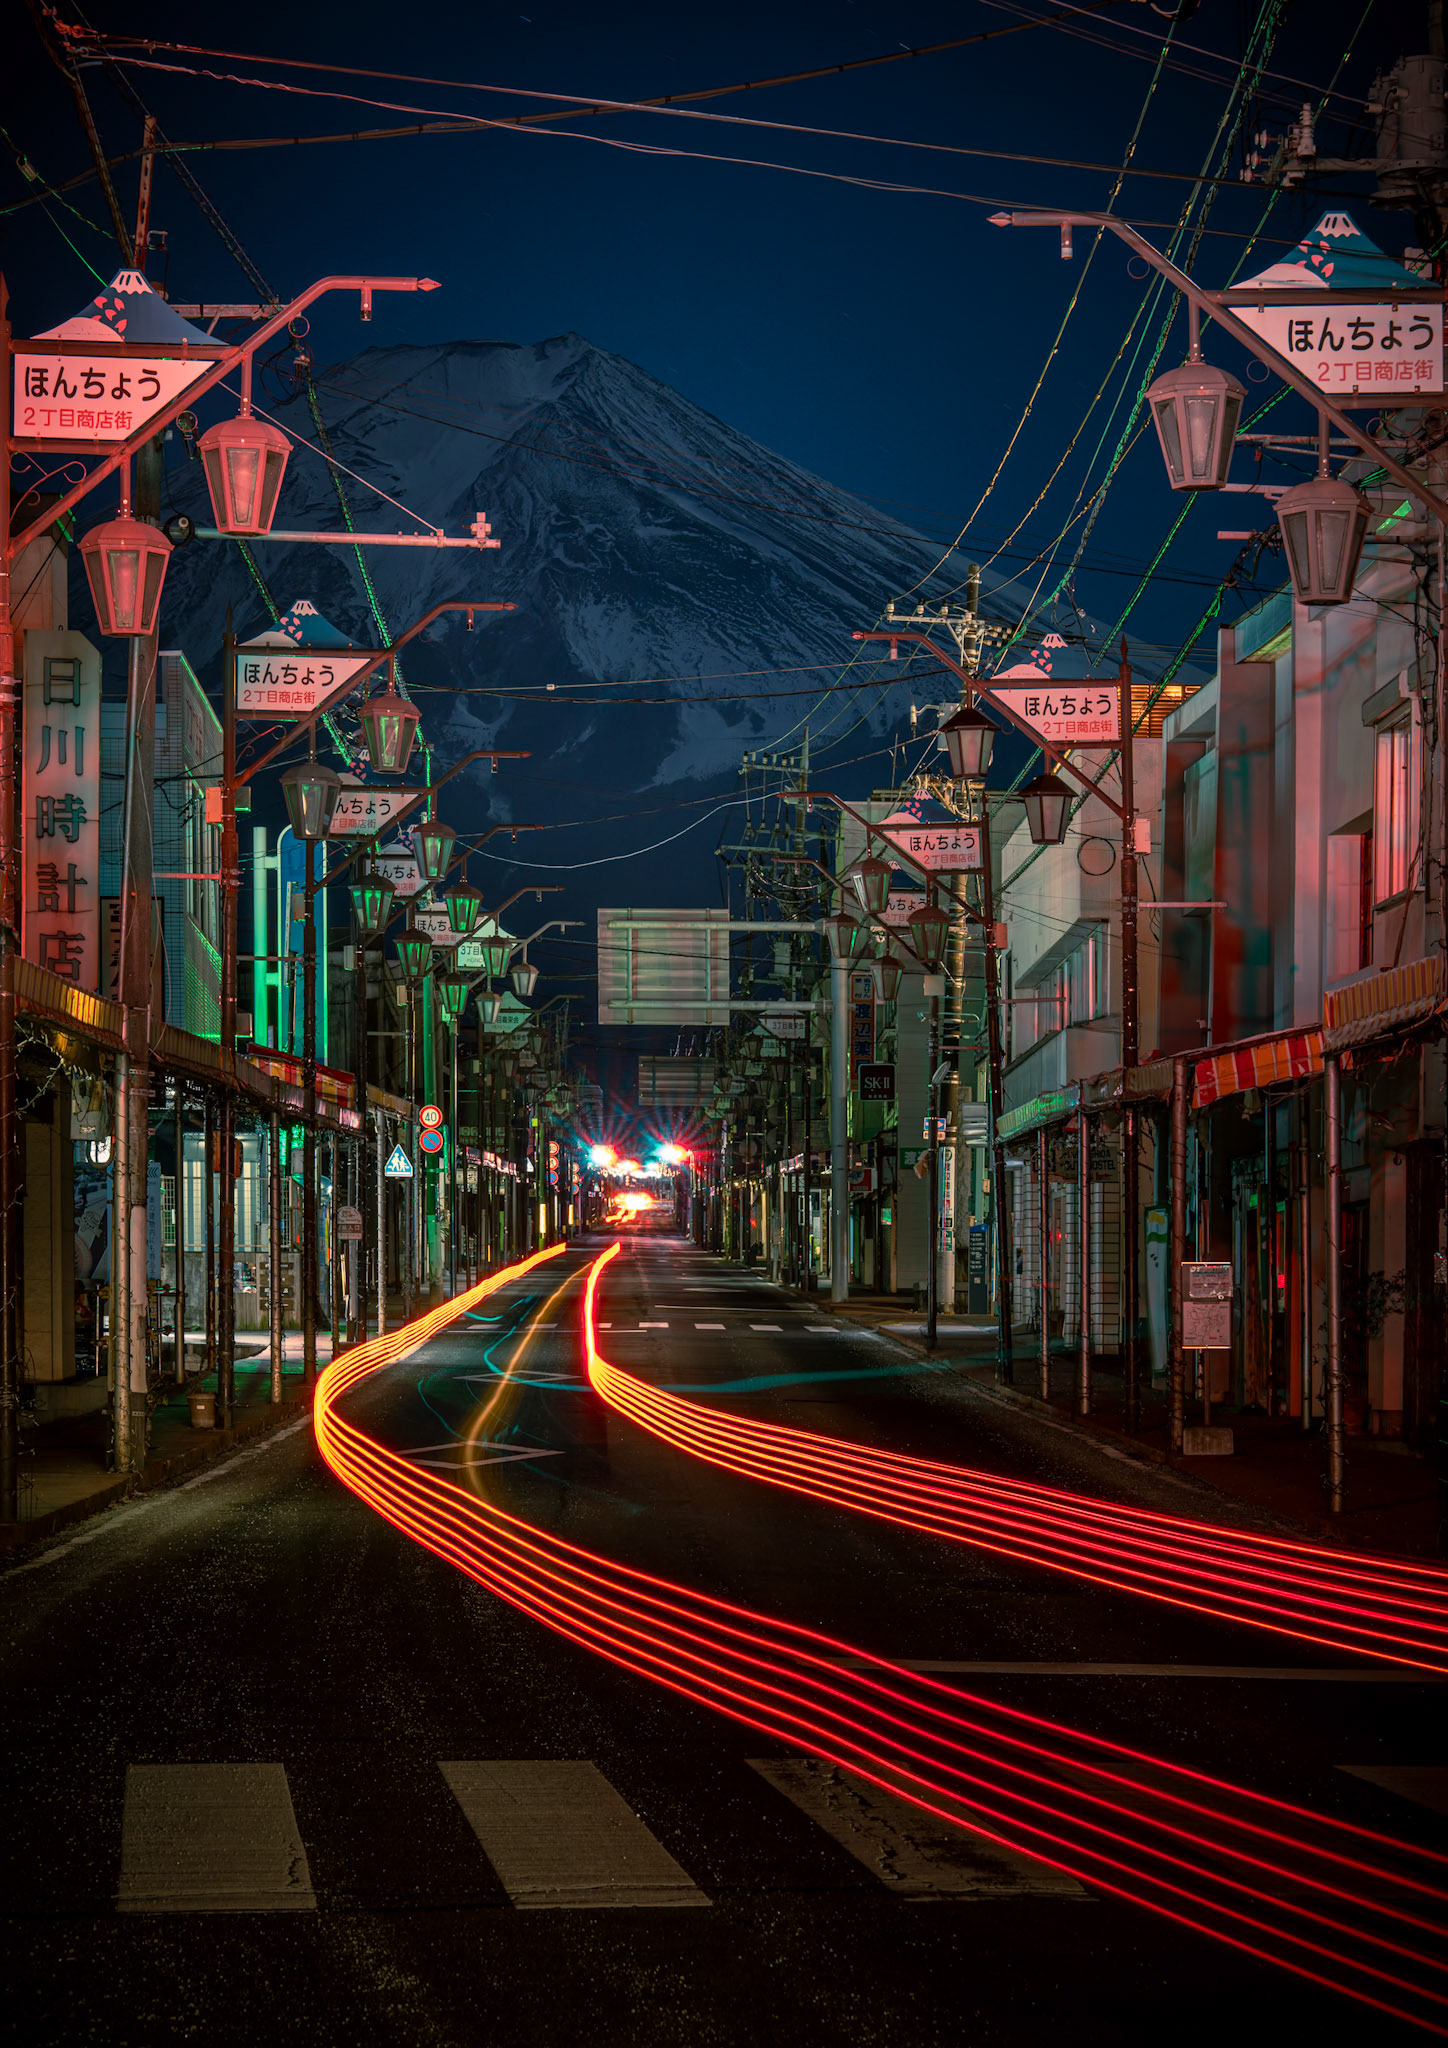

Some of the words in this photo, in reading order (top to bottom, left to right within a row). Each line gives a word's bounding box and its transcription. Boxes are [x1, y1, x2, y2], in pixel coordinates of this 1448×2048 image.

[1288, 315, 1434, 352] ほんちょう
[1318, 360, 1434, 382] 2丁目商店街
[24, 365, 161, 402] ほんちょう
[23, 406, 134, 430] 2丁目商店街
[244, 663, 335, 687] ほんちょう
[243, 689, 316, 705] 2丁目商店街
[1025, 694, 1111, 717] ほんちょう
[1043, 720, 1112, 734] 2丁目商店街
[335, 798, 391, 816] んちょう
[36, 656, 88, 981] 日川時計店
[331, 818, 377, 829] 丁目商店街
[909, 833, 975, 852] ほんちょう
[923, 853, 976, 865] 2丁目商店街
[460, 946, 482, 956] 3丁目
[424, 1111, 438, 1122] 40
